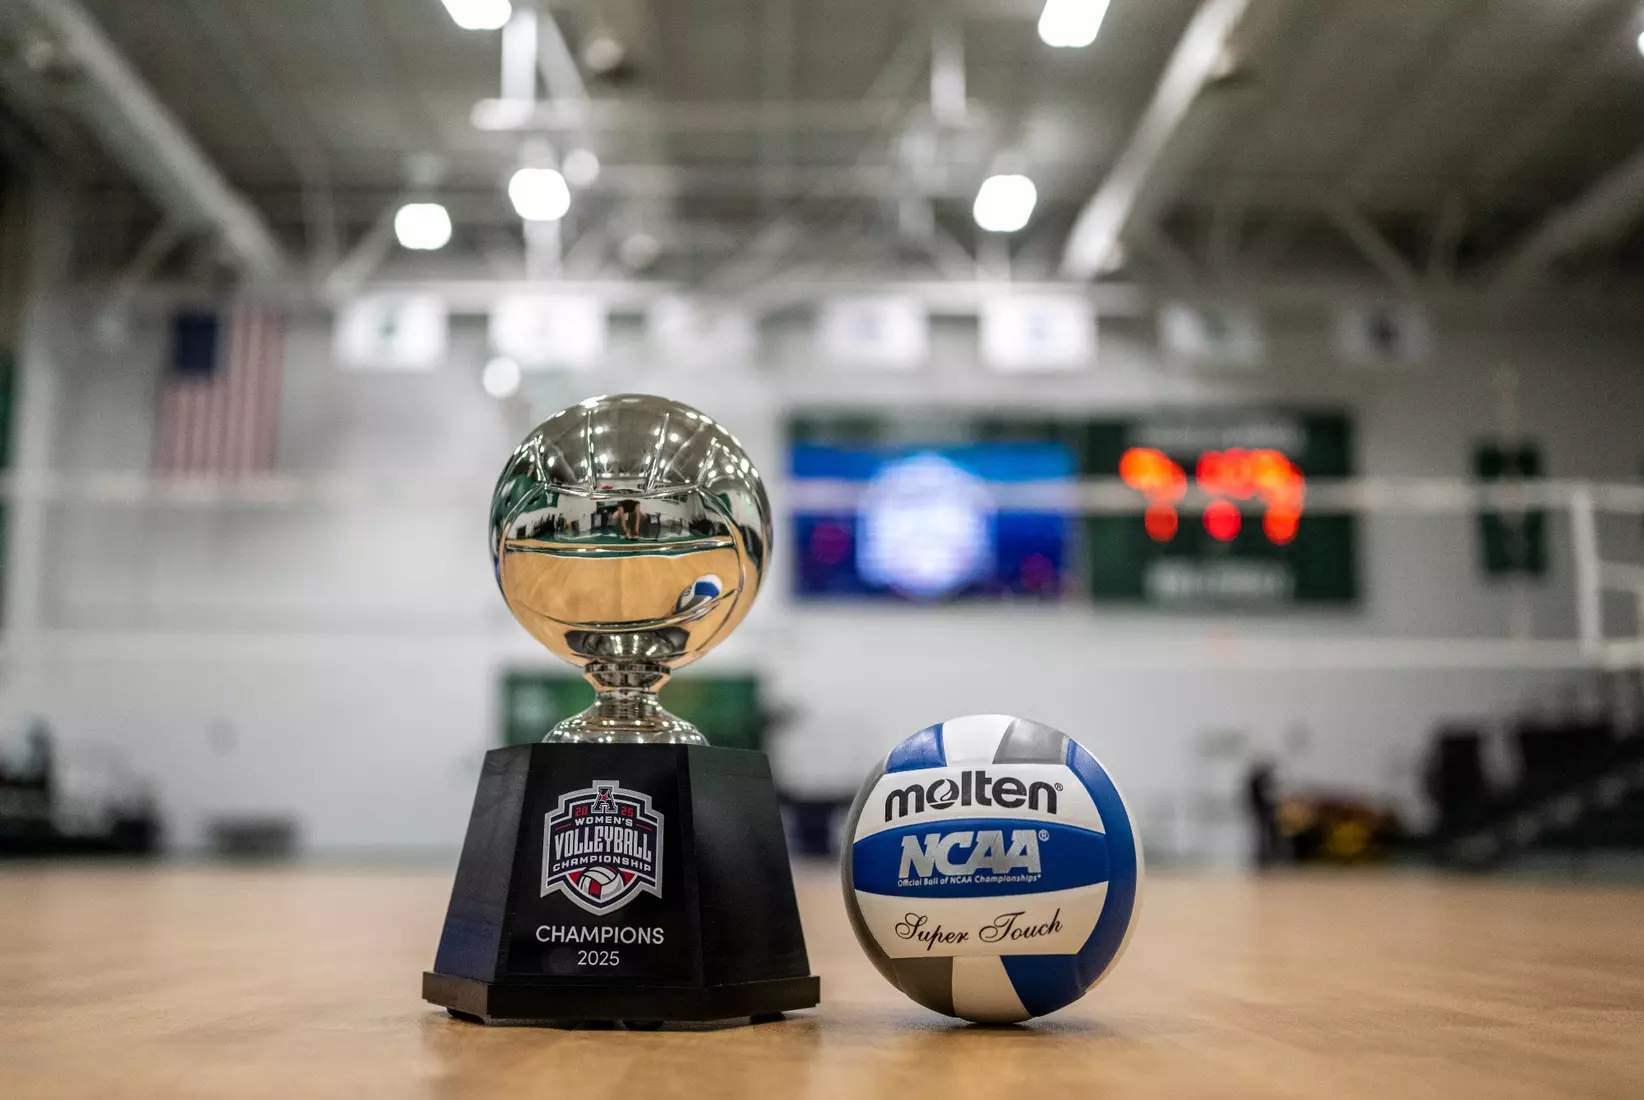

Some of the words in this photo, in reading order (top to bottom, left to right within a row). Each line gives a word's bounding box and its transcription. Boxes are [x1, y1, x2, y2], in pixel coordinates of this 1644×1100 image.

[574, 806, 589, 817] 20
[620, 806, 634, 817] 25
[575, 815, 633, 827] WOMEN'S
[554, 826, 652, 862] VOLLEYBALL
[552, 854, 652, 872] CHAMPIONSHIP
[897, 877, 922, 888] Official
[923, 876, 939, 886] Ball
[940, 874, 949, 885] of
[950, 874, 973, 884] NCAA
[535, 925, 665, 945] CHAMPIONS
[894, 912, 969, 951] Super
[978, 908, 1063, 943] Touch
[577, 950, 620, 966] 2025
